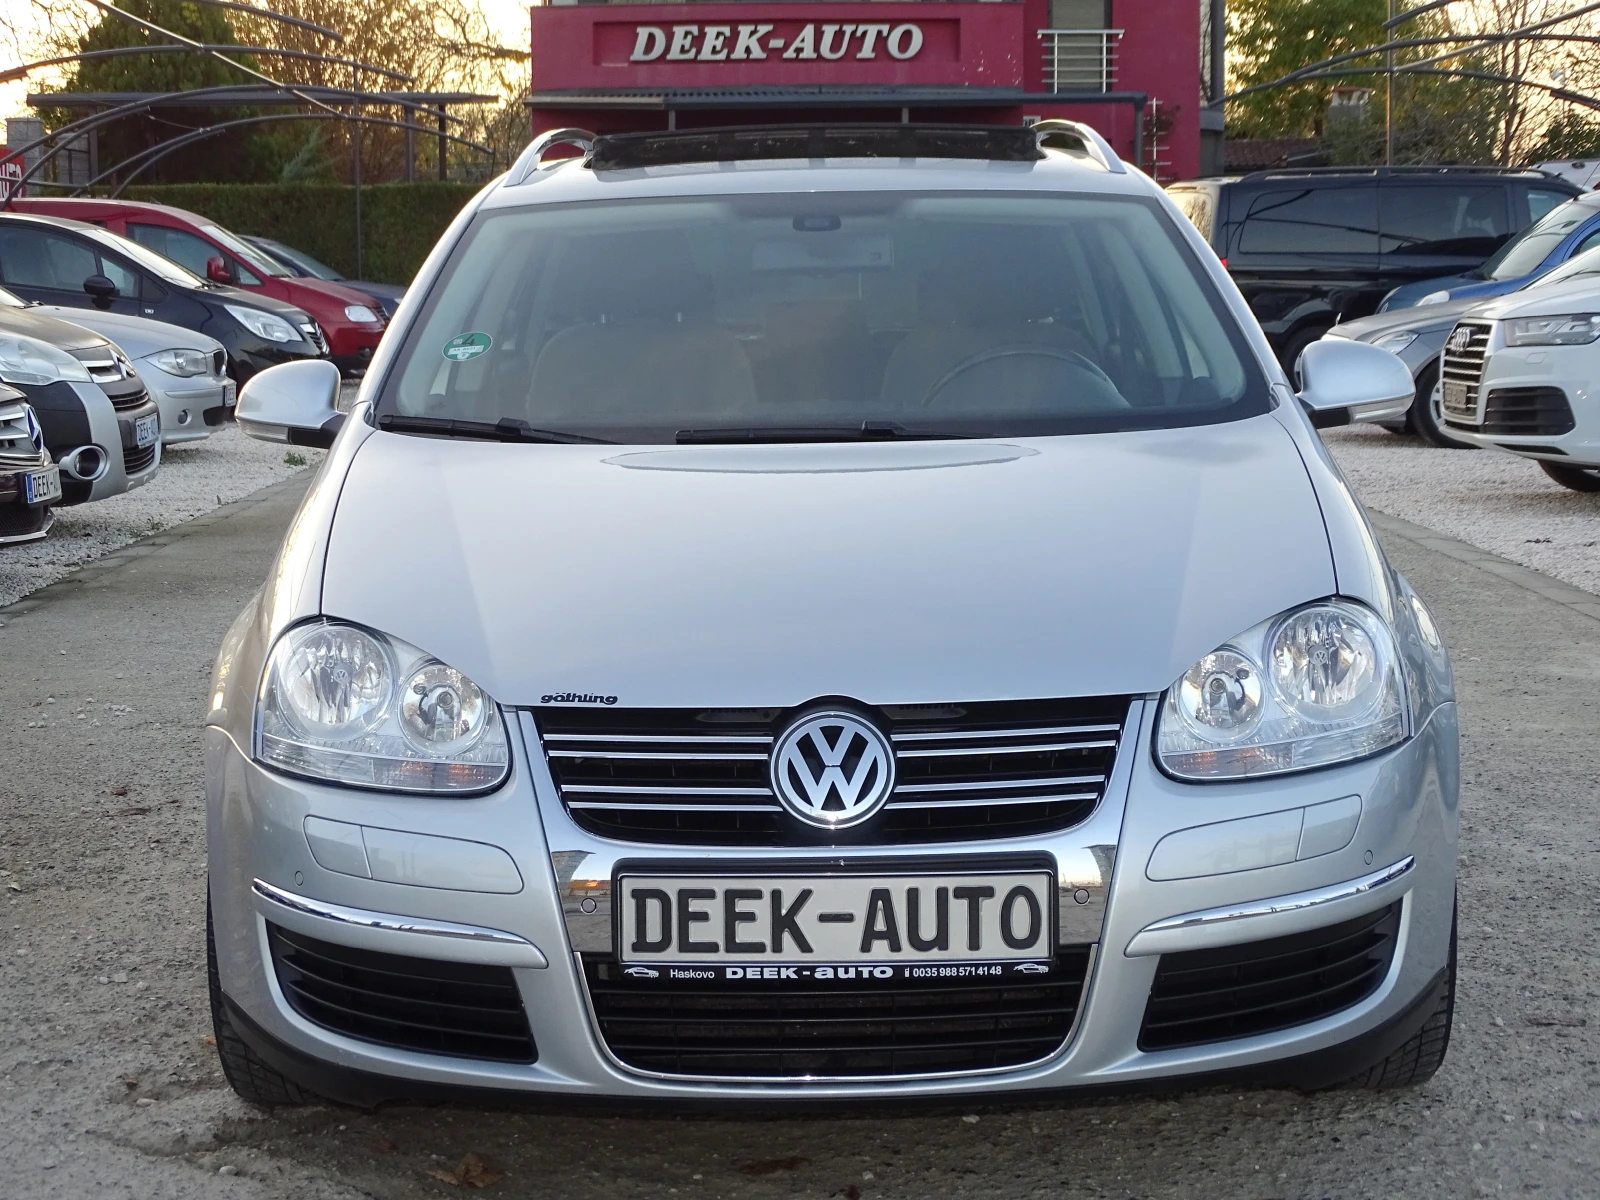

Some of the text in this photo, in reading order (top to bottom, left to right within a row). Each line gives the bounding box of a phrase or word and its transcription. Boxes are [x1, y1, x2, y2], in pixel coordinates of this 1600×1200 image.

[630, 23, 924, 62] DEEK-AUTO
[630, 885, 1043, 953] DEEK-AUTO
[670, 968, 715, 979] Haskovo
[912, 967, 938, 977] 0035
[939, 966, 957, 977] 988
[989, 965, 1002, 976] 48
